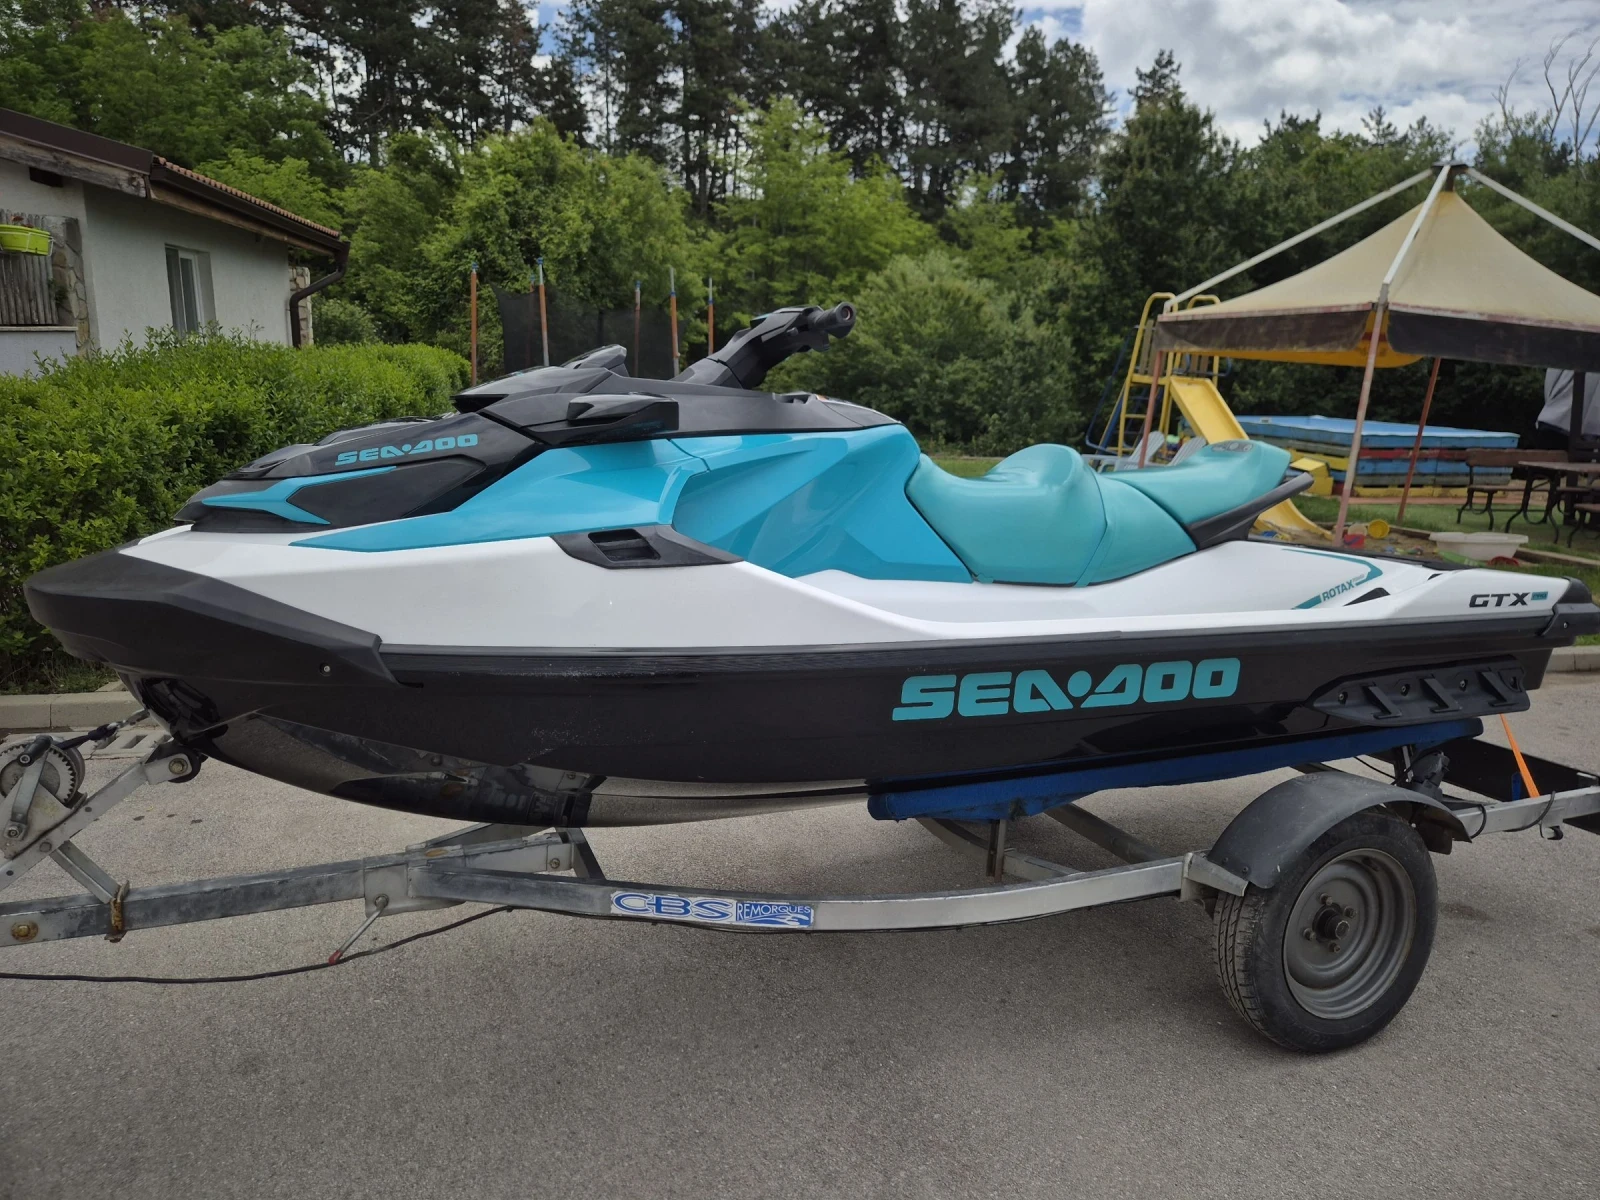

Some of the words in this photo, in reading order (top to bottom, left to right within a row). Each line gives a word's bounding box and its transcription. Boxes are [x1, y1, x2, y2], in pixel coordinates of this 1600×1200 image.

[1321, 579, 1355, 602] ROTAX
[1469, 592, 1530, 608] GTX
[612, 892, 733, 921] CBS
[736, 903, 811, 921] REMORQUES
